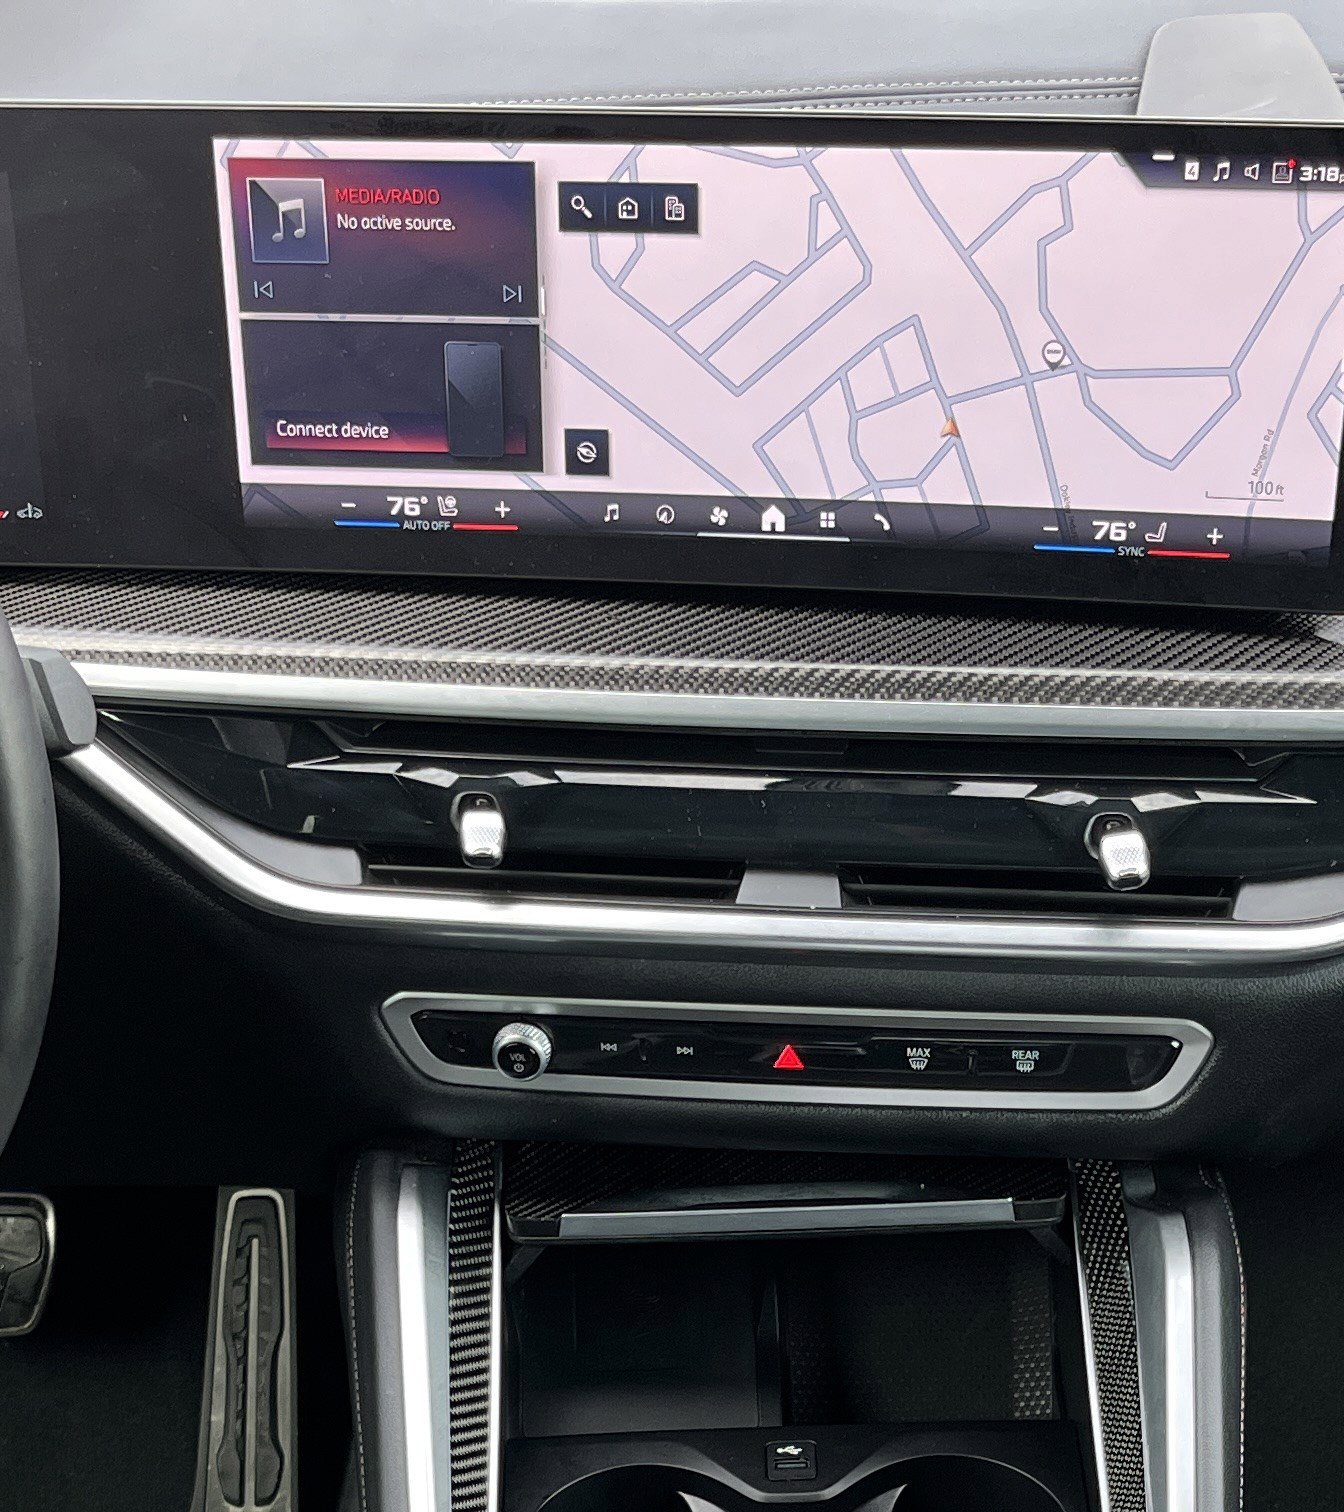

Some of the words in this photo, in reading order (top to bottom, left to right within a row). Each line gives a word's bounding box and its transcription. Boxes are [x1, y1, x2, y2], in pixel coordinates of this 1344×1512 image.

[336, 188, 440, 205] MEDIA/RADIO
[336, 213, 358, 229] No
[361, 215, 402, 230] active
[404, 217, 456, 231] source.
[276, 420, 339, 438] Connect
[341, 422, 389, 439] device
[1248, 481, 1273, 495] 100
[1276, 484, 1285, 495] ft
[403, 520, 430, 531] AUTO
[431, 521, 451, 531] OFF
[1117, 546, 1145, 558] SYNC
[906, 1047, 931, 1058] MAX
[1011, 1050, 1039, 1060] REAR
